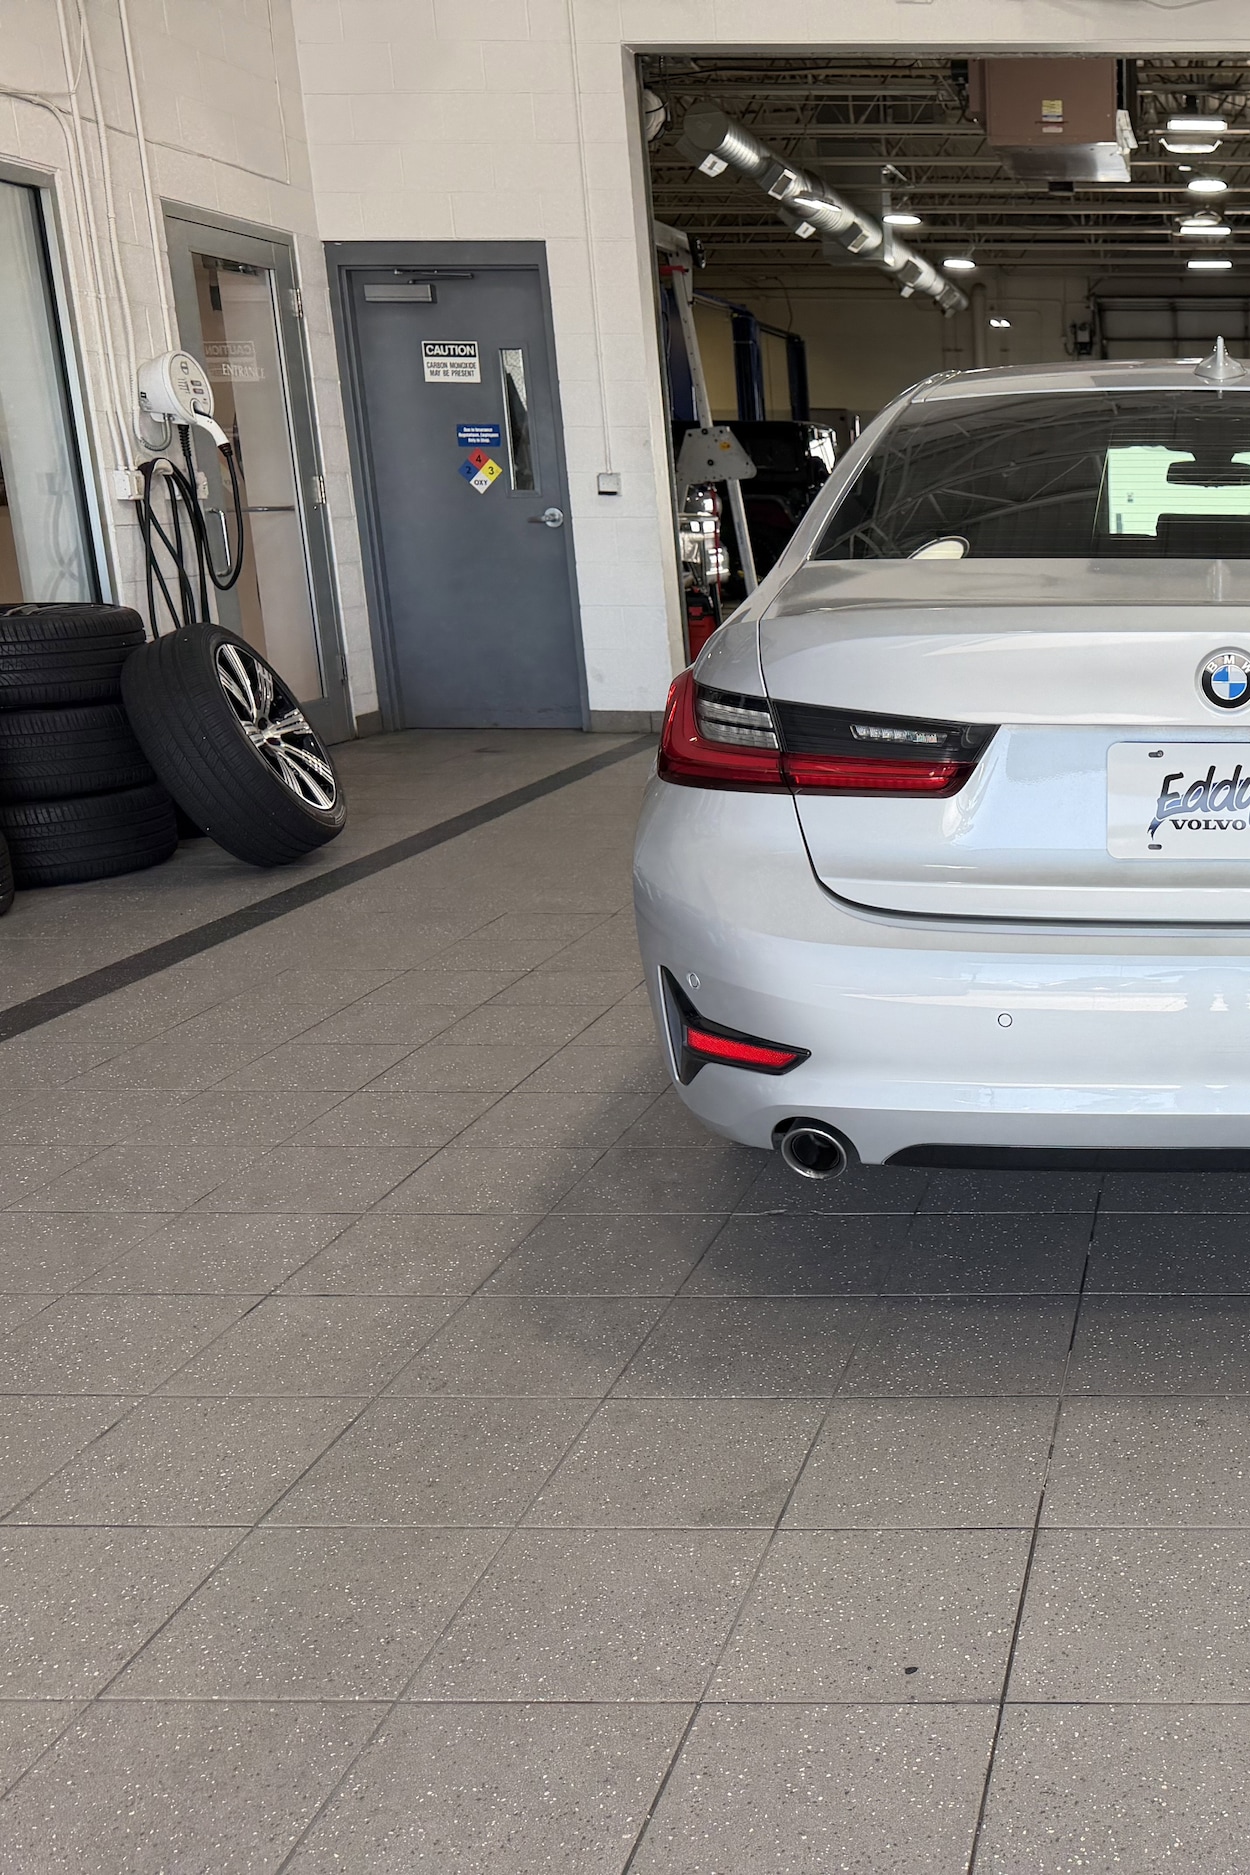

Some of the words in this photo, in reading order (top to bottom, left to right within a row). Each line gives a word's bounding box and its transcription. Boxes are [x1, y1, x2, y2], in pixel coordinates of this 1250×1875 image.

[426, 345, 475, 356] CAUTION
[426, 361, 448, 369] CARBON
[449, 361, 477, 369] MONOXIDE
[222, 363, 266, 379] ENTRANCE
[430, 369, 441, 377] MAY
[475, 454, 482, 463] 4
[465, 466, 472, 474] 2
[488, 466, 495, 475] 3
[1169, 819, 1246, 830] VOLVO
